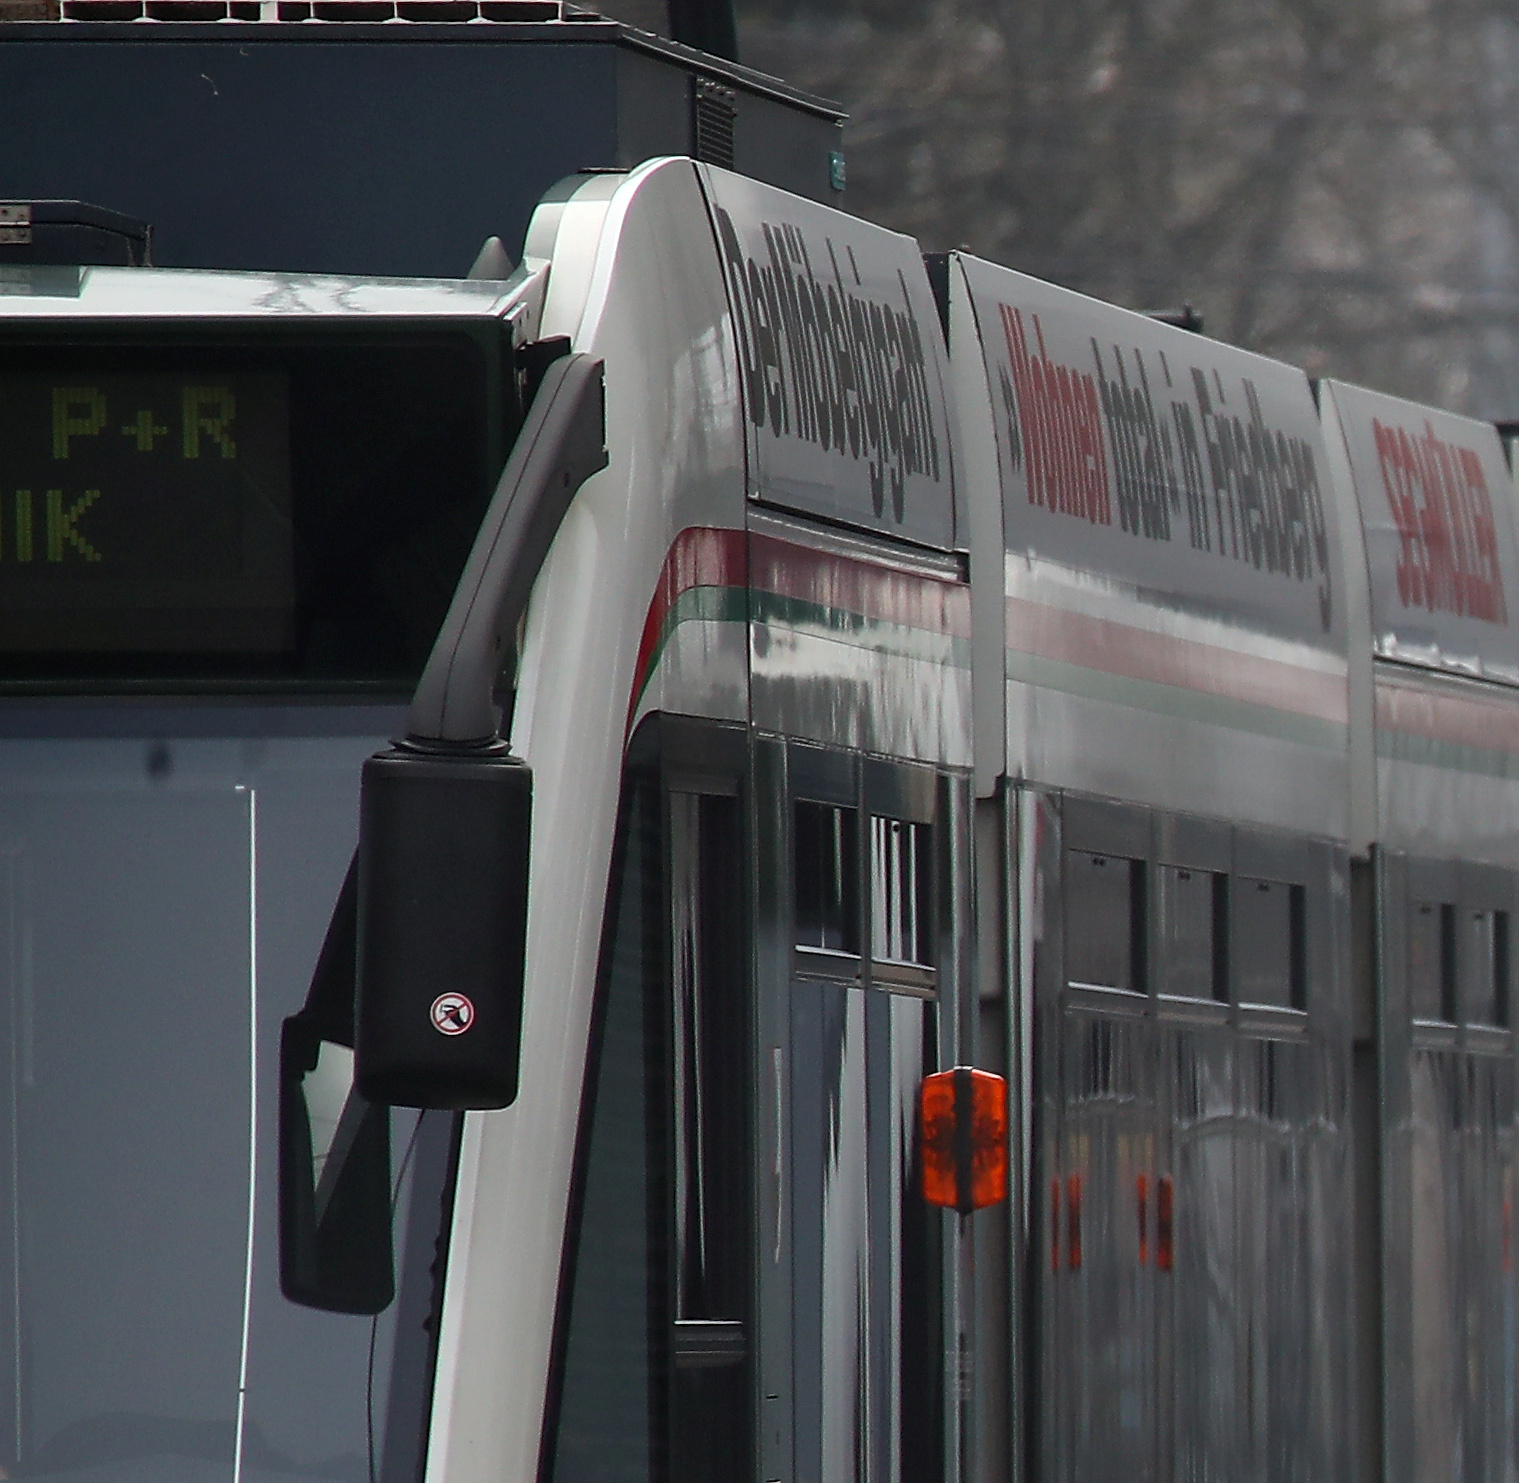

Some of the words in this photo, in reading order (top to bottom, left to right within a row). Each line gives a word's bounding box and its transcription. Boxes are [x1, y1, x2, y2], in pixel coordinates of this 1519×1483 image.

[52, 386, 237, 460] P+R
[713, 203, 790, 437] Der
[761, 221, 940, 524] Möbelgigant
[1160, 350, 1211, 553] in
[1190, 365, 1333, 633] Friedberg
